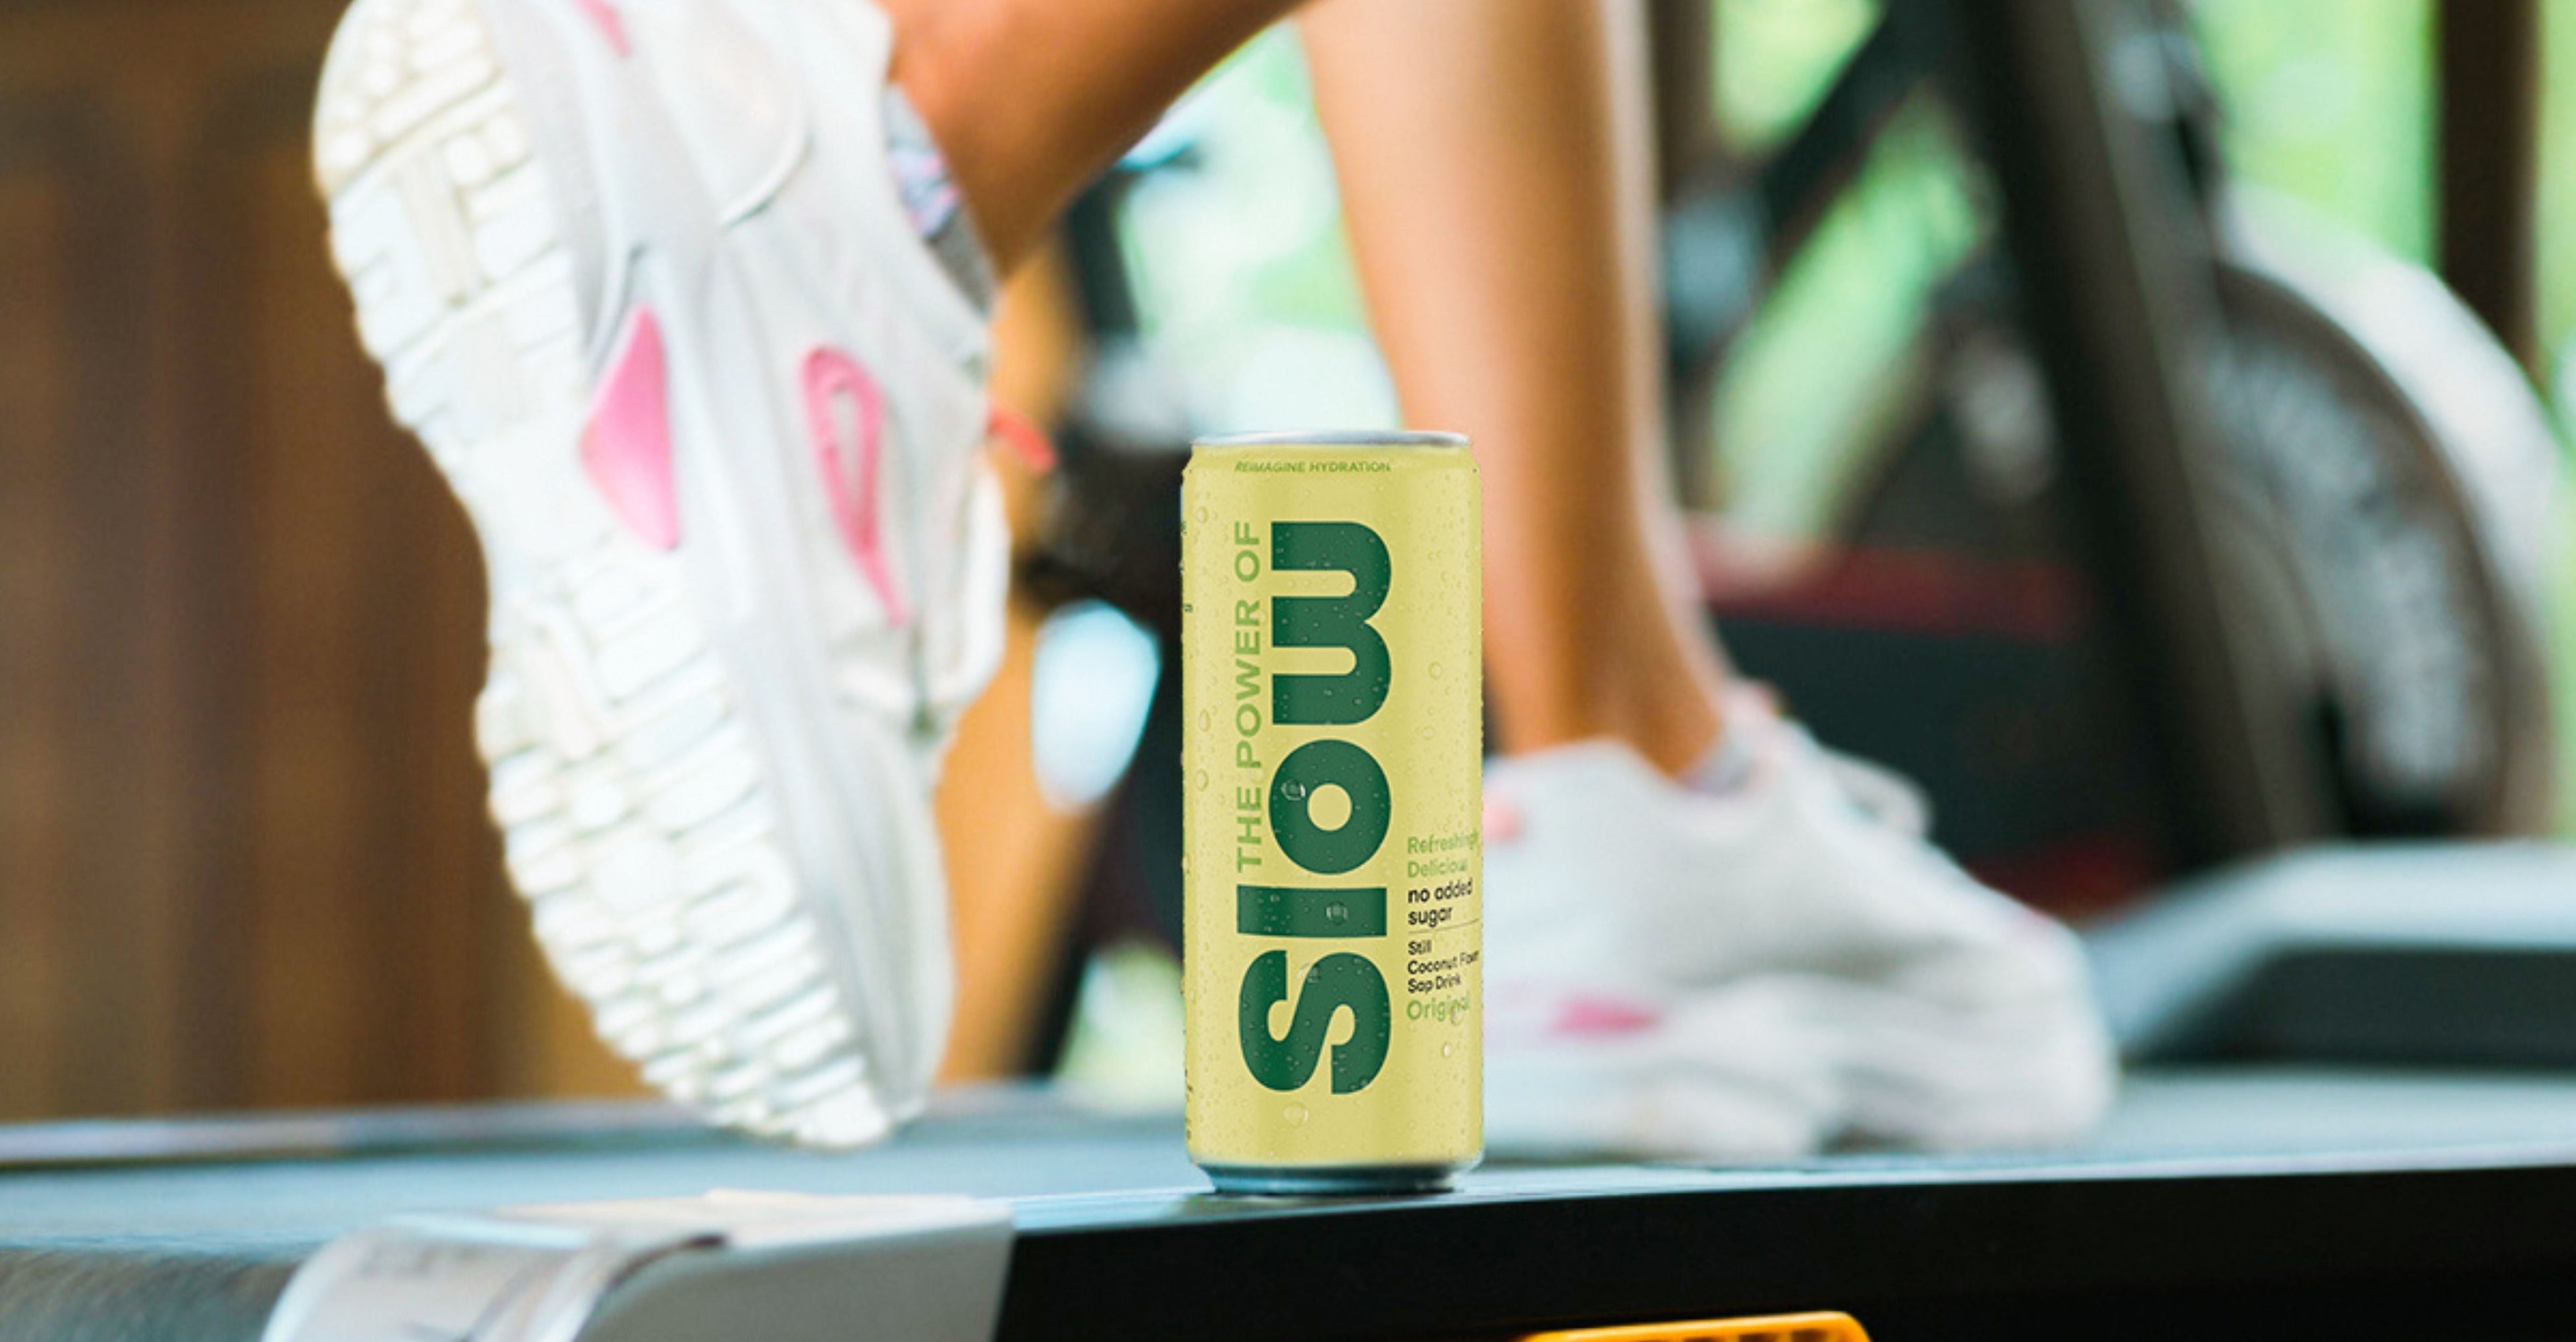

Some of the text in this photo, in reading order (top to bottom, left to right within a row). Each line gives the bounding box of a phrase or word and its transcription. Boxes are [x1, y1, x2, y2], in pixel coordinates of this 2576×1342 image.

[1235, 460, 1391, 472] REIMAGINE HYDRATION
[1234, 521, 1262, 873] THE POWER OF
[1407, 878, 1473, 903] no added
[1407, 907, 1453, 927] sugar
[1407, 939, 1432, 955] Still
[1407, 974, 1460, 994] Sap Drink
